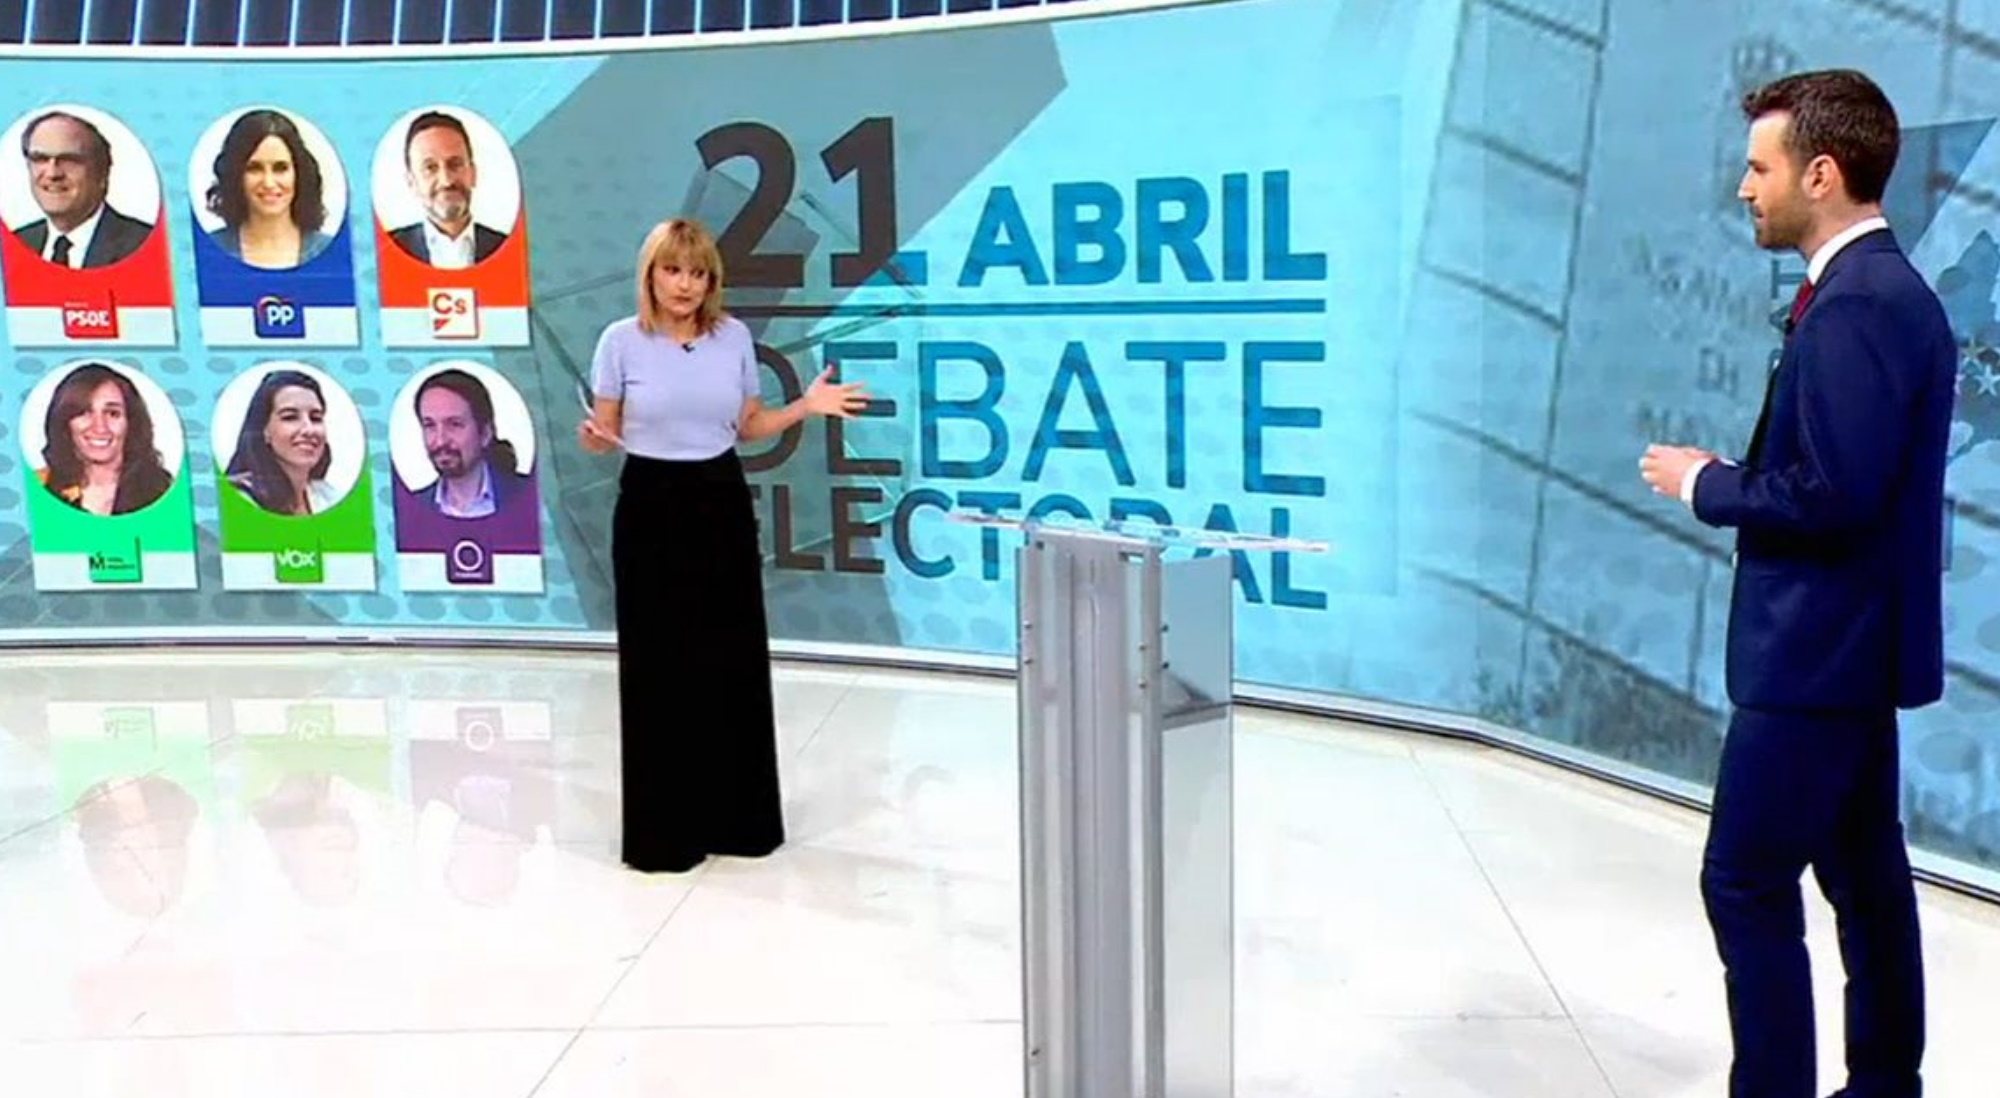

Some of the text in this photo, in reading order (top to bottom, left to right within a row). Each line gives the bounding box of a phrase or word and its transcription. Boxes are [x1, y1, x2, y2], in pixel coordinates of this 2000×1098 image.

[694, 116, 1327, 288] 21 ABRIL
[66, 310, 111, 327] PSOE
[432, 292, 468, 315] Cs
[752, 483, 1327, 610] LECTAL
